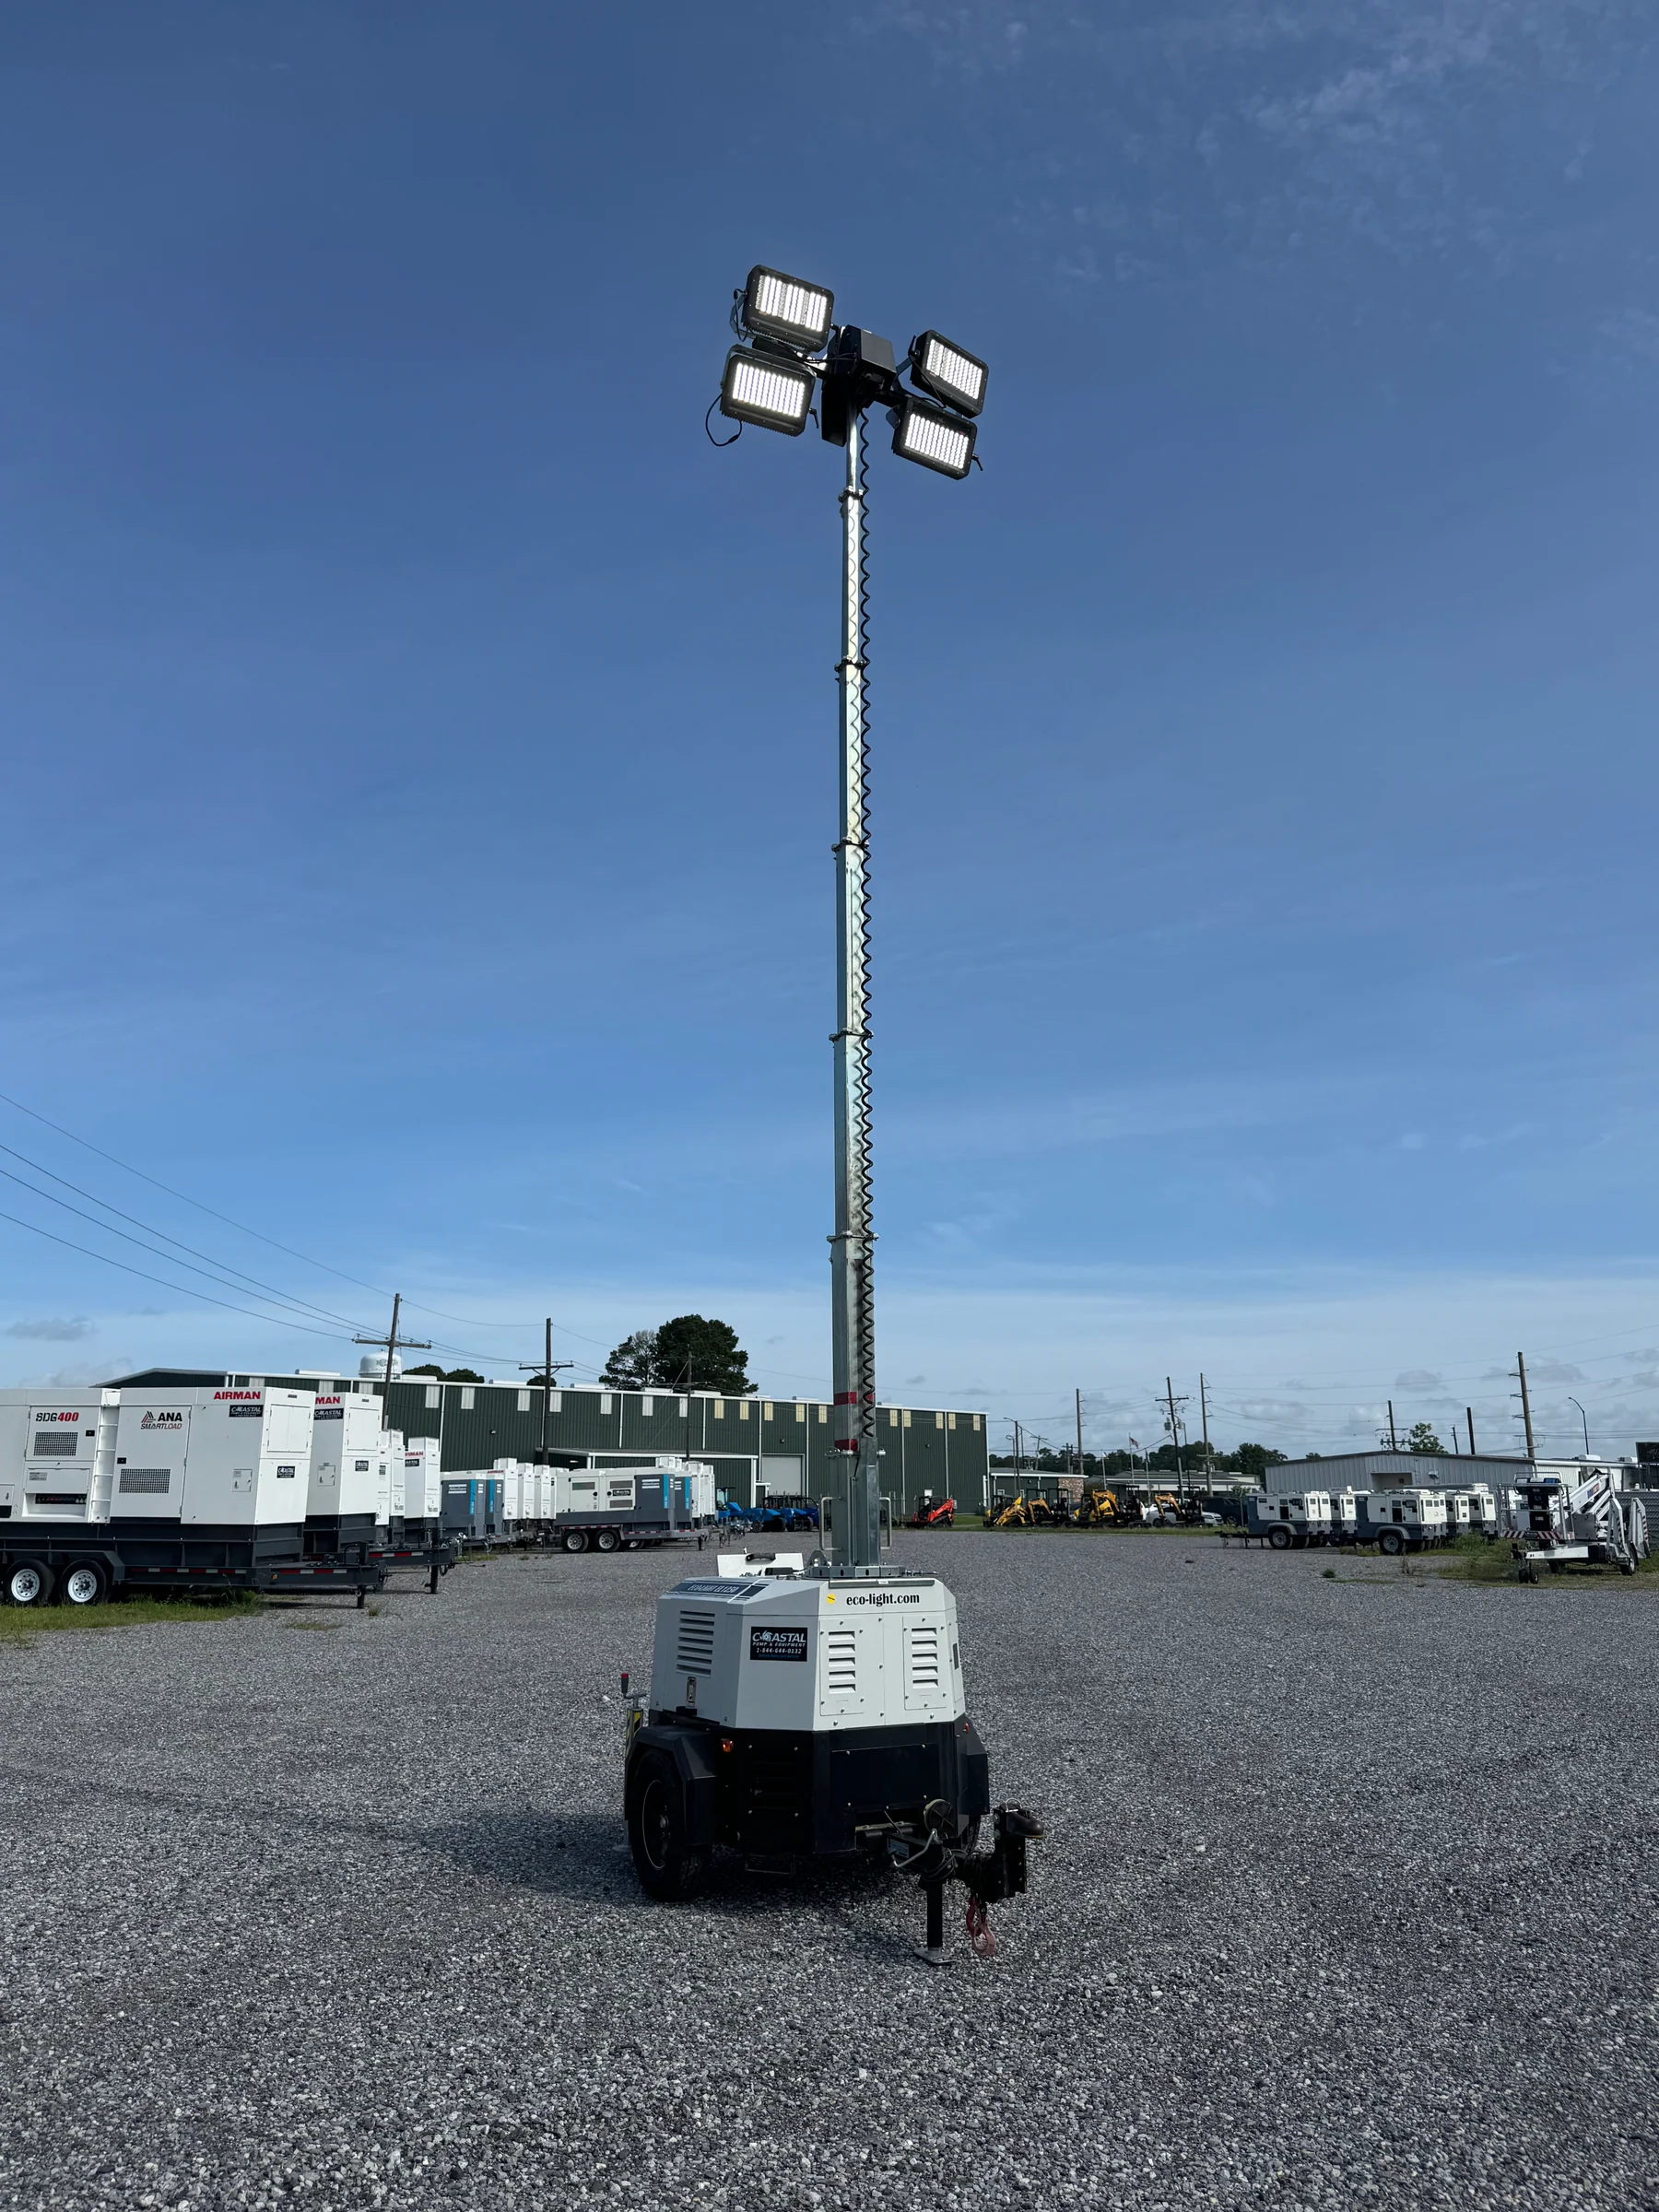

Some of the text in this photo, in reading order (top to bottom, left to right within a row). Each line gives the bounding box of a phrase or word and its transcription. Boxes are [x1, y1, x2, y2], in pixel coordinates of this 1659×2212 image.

[213, 1391, 261, 1400] AIRMAN
[35, 1412, 79, 1422] SDG400
[158, 1412, 182, 1422] ANA
[846, 1593, 920, 1607] eco-light.com
[752, 1630, 806, 1642] COASTAL
